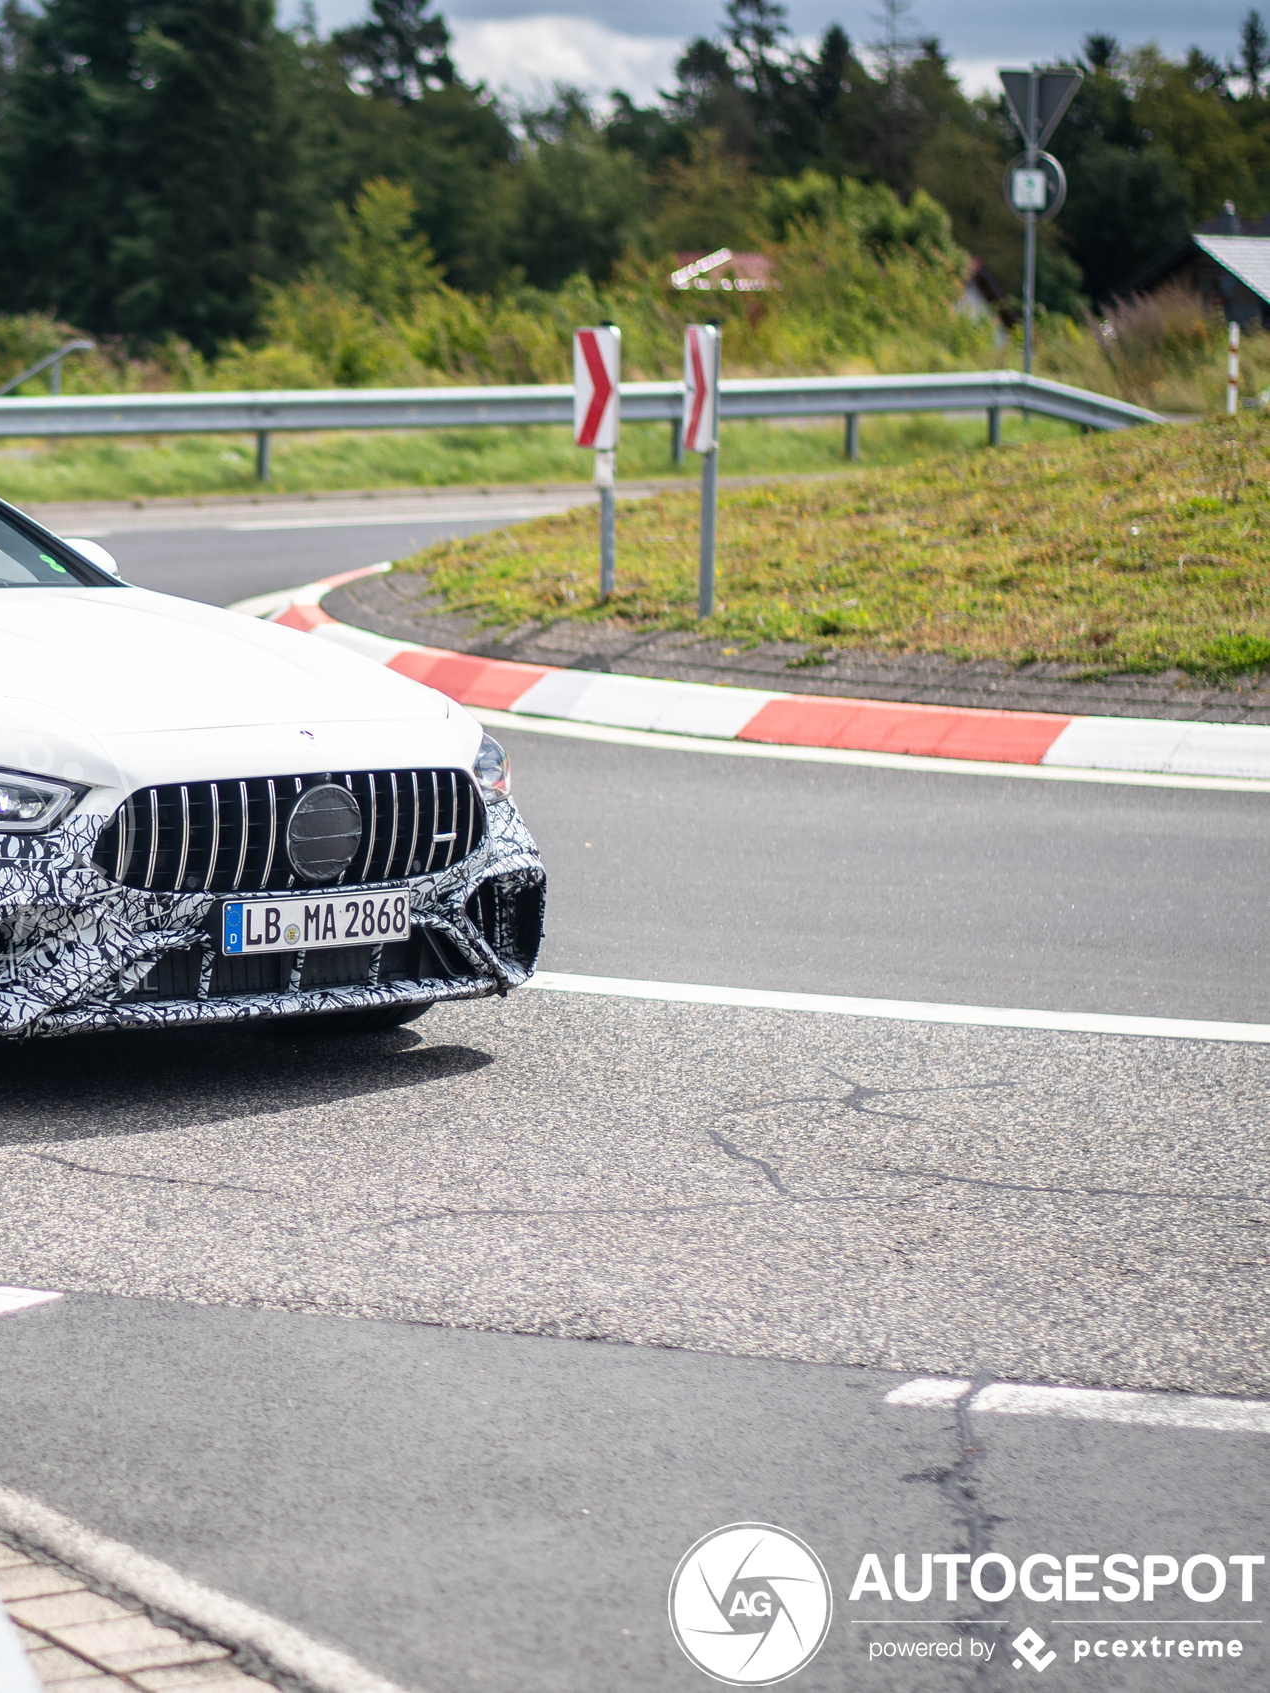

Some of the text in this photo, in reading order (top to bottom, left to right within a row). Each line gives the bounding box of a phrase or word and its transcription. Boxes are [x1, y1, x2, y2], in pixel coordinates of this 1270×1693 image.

[246, 896, 406, 945] LB MA 2868
[230, 933, 238, 944] D
